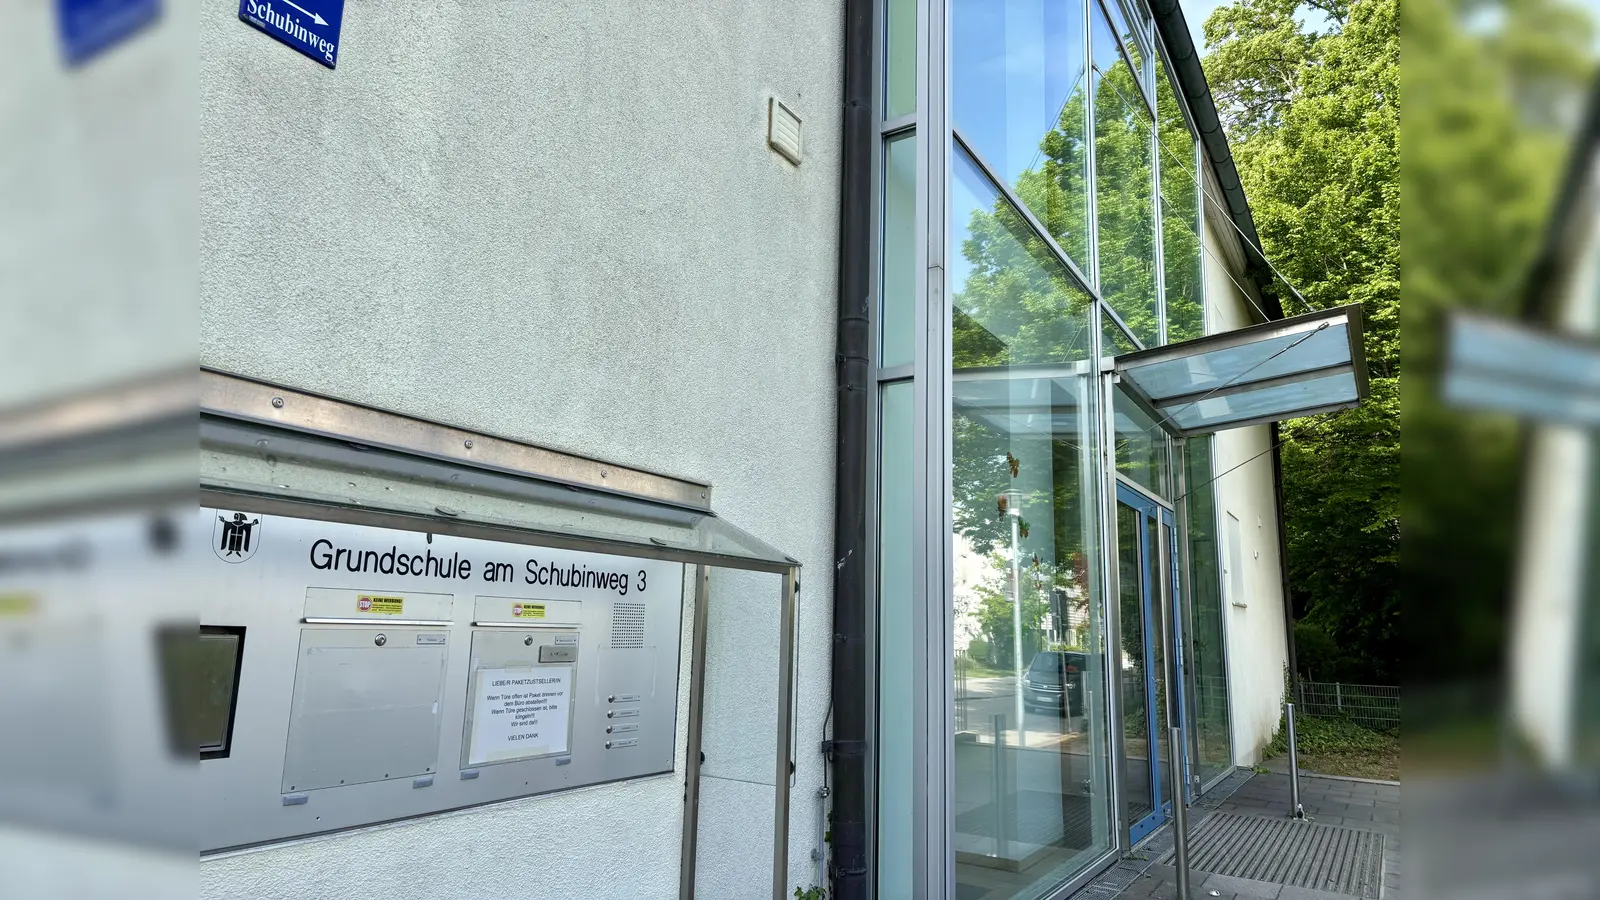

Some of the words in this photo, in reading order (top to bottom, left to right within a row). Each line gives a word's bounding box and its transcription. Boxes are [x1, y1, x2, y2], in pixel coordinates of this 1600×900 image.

[247, 0, 335, 62] Schubinweg
[309, 538, 471, 580] Grundschule
[483, 561, 514, 584] am
[524, 558, 629, 595] Schubinweg
[636, 569, 647, 592] 3
